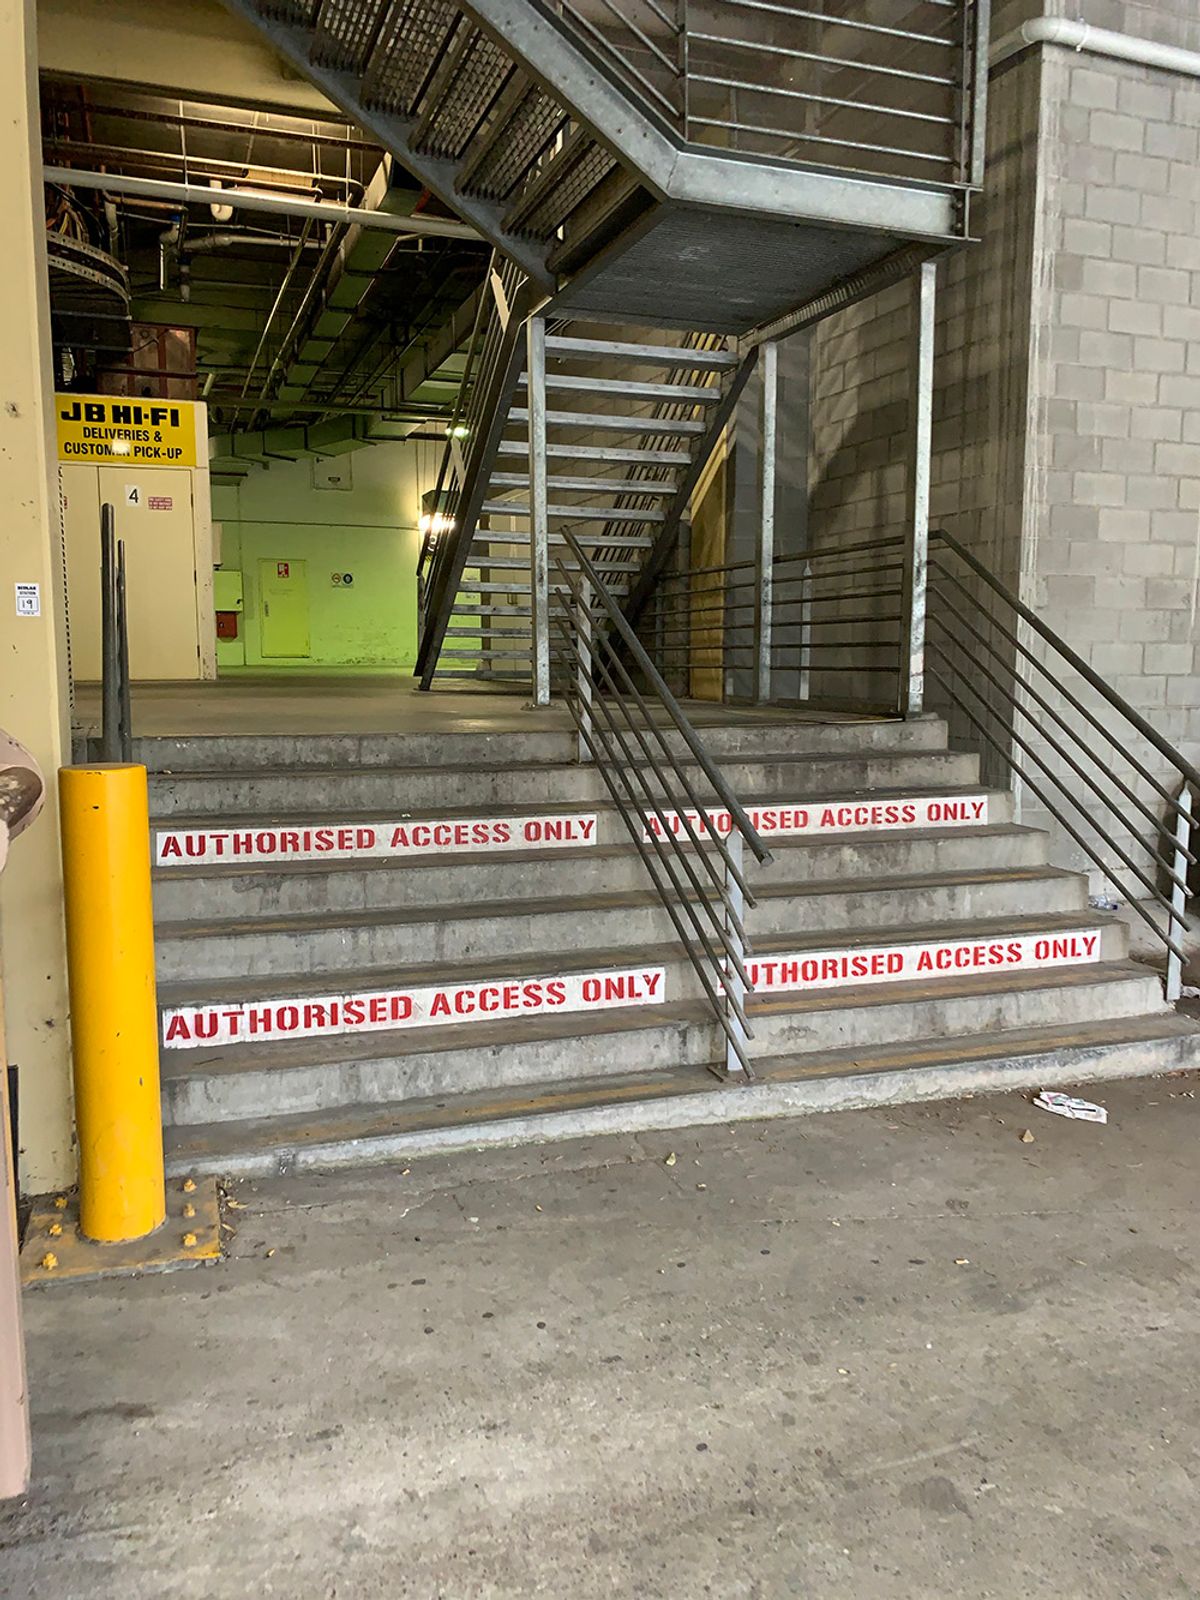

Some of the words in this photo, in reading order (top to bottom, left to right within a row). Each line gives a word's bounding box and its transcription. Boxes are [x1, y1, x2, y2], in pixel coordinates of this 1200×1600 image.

[61, 402, 106, 422] JB
[112, 405, 180, 427] HI-FI
[83, 427, 150, 442] DELIVERIES
[154, 431, 162, 442] &
[64, 442, 130, 457] CUSTOM
[134, 446, 183, 459] PICK-UP
[129, 489, 139, 503] 4
[820, 804, 916, 827] ACCESS
[927, 801, 984, 823] ONLY
[162, 828, 375, 858] AUTHORISED
[391, 823, 511, 848] ACCESS
[524, 819, 595, 842] ONLY
[719, 953, 903, 989] UTHORISED
[916, 942, 1022, 972] ACCESS
[1035, 935, 1097, 961] ONLY
[166, 996, 412, 1041] AUTHORISED
[430, 981, 567, 1017] ACCESS
[582, 972, 661, 1003] ONLY
